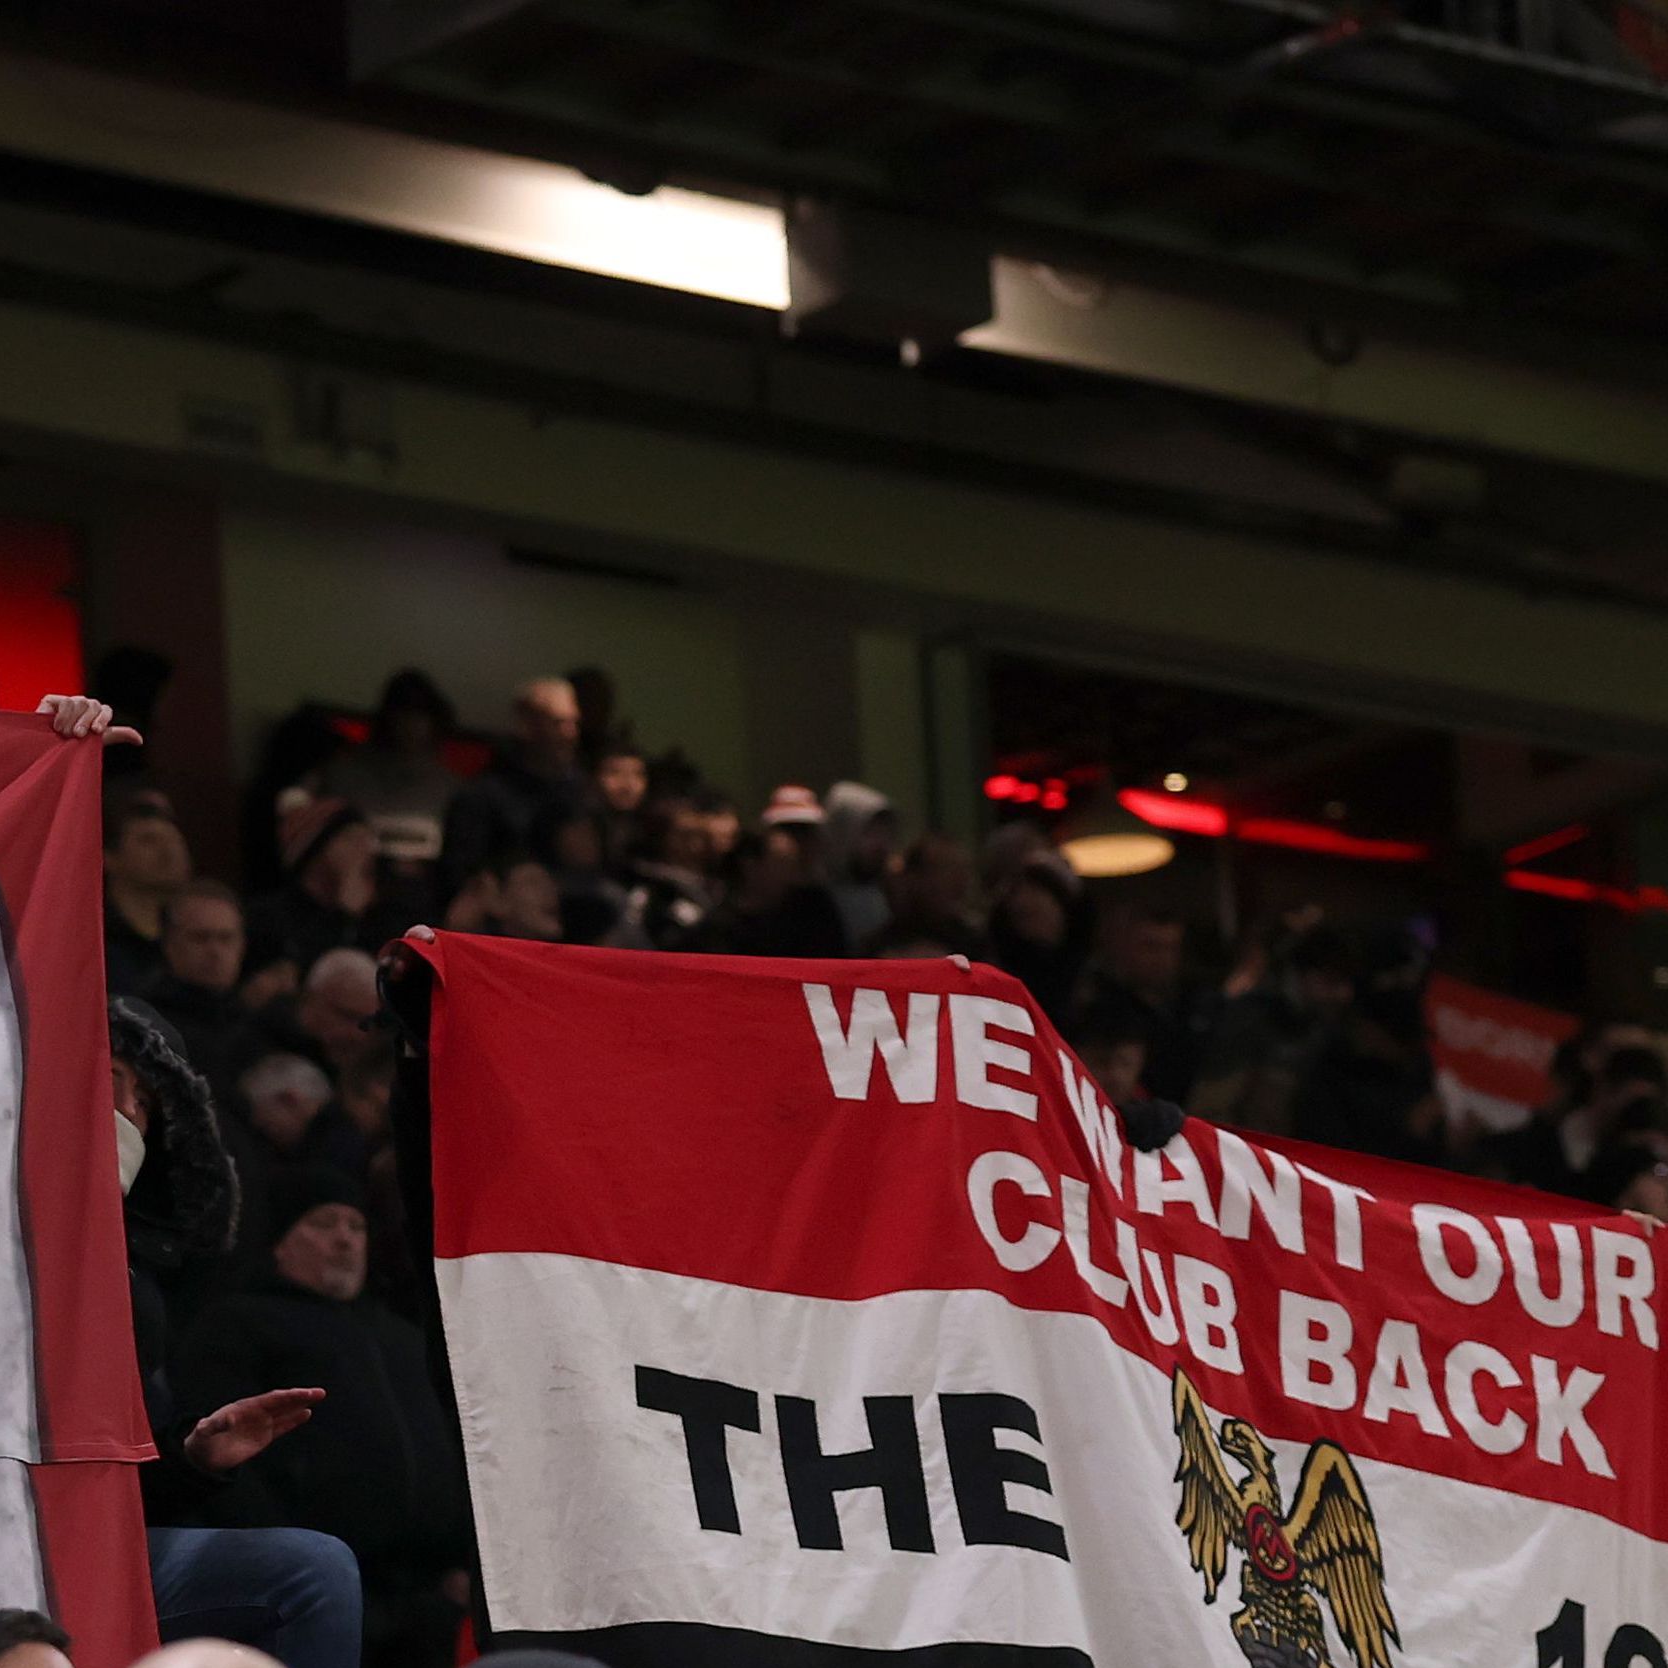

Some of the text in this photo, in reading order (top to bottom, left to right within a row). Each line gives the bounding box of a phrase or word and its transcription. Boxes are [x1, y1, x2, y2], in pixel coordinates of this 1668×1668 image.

[802, 983, 1660, 1351] WE WANT OUR
[966, 1150, 1616, 1480] CLUB BACK
[635, 1365, 1070, 1562] THE
